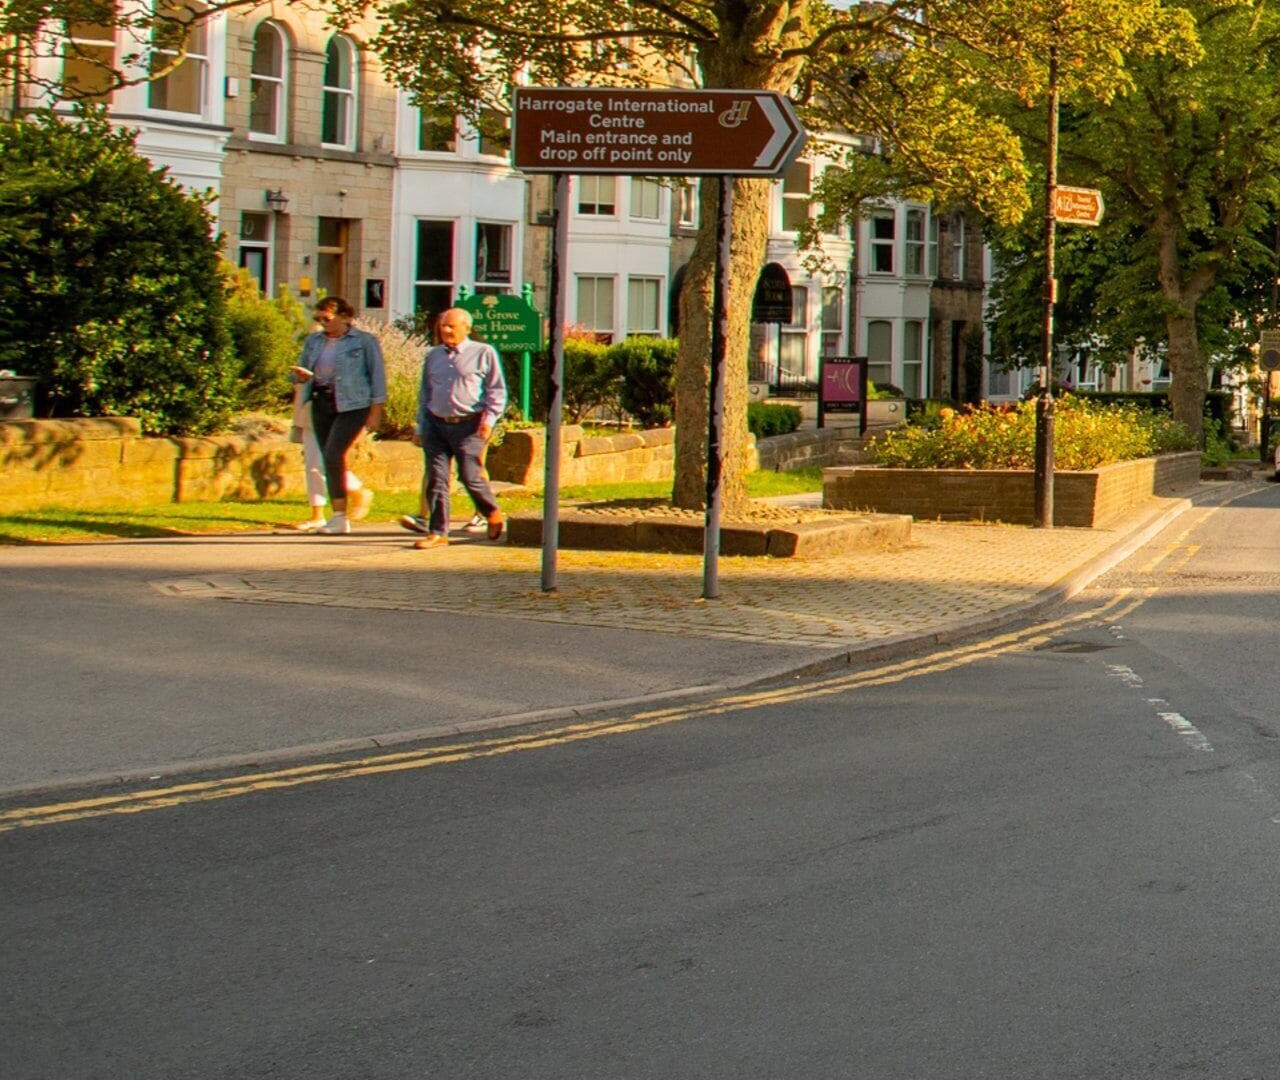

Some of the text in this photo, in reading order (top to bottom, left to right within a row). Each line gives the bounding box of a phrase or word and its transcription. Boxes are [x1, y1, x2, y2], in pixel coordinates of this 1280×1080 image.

[519, 97, 715, 113] Harrogate International
[589, 115, 645, 128] Centre
[540, 130, 692, 145] Main entrance and
[540, 147, 692, 163] drop off point only
[472, 309, 519, 319] sh Grove
[491, 321, 526, 331] House
